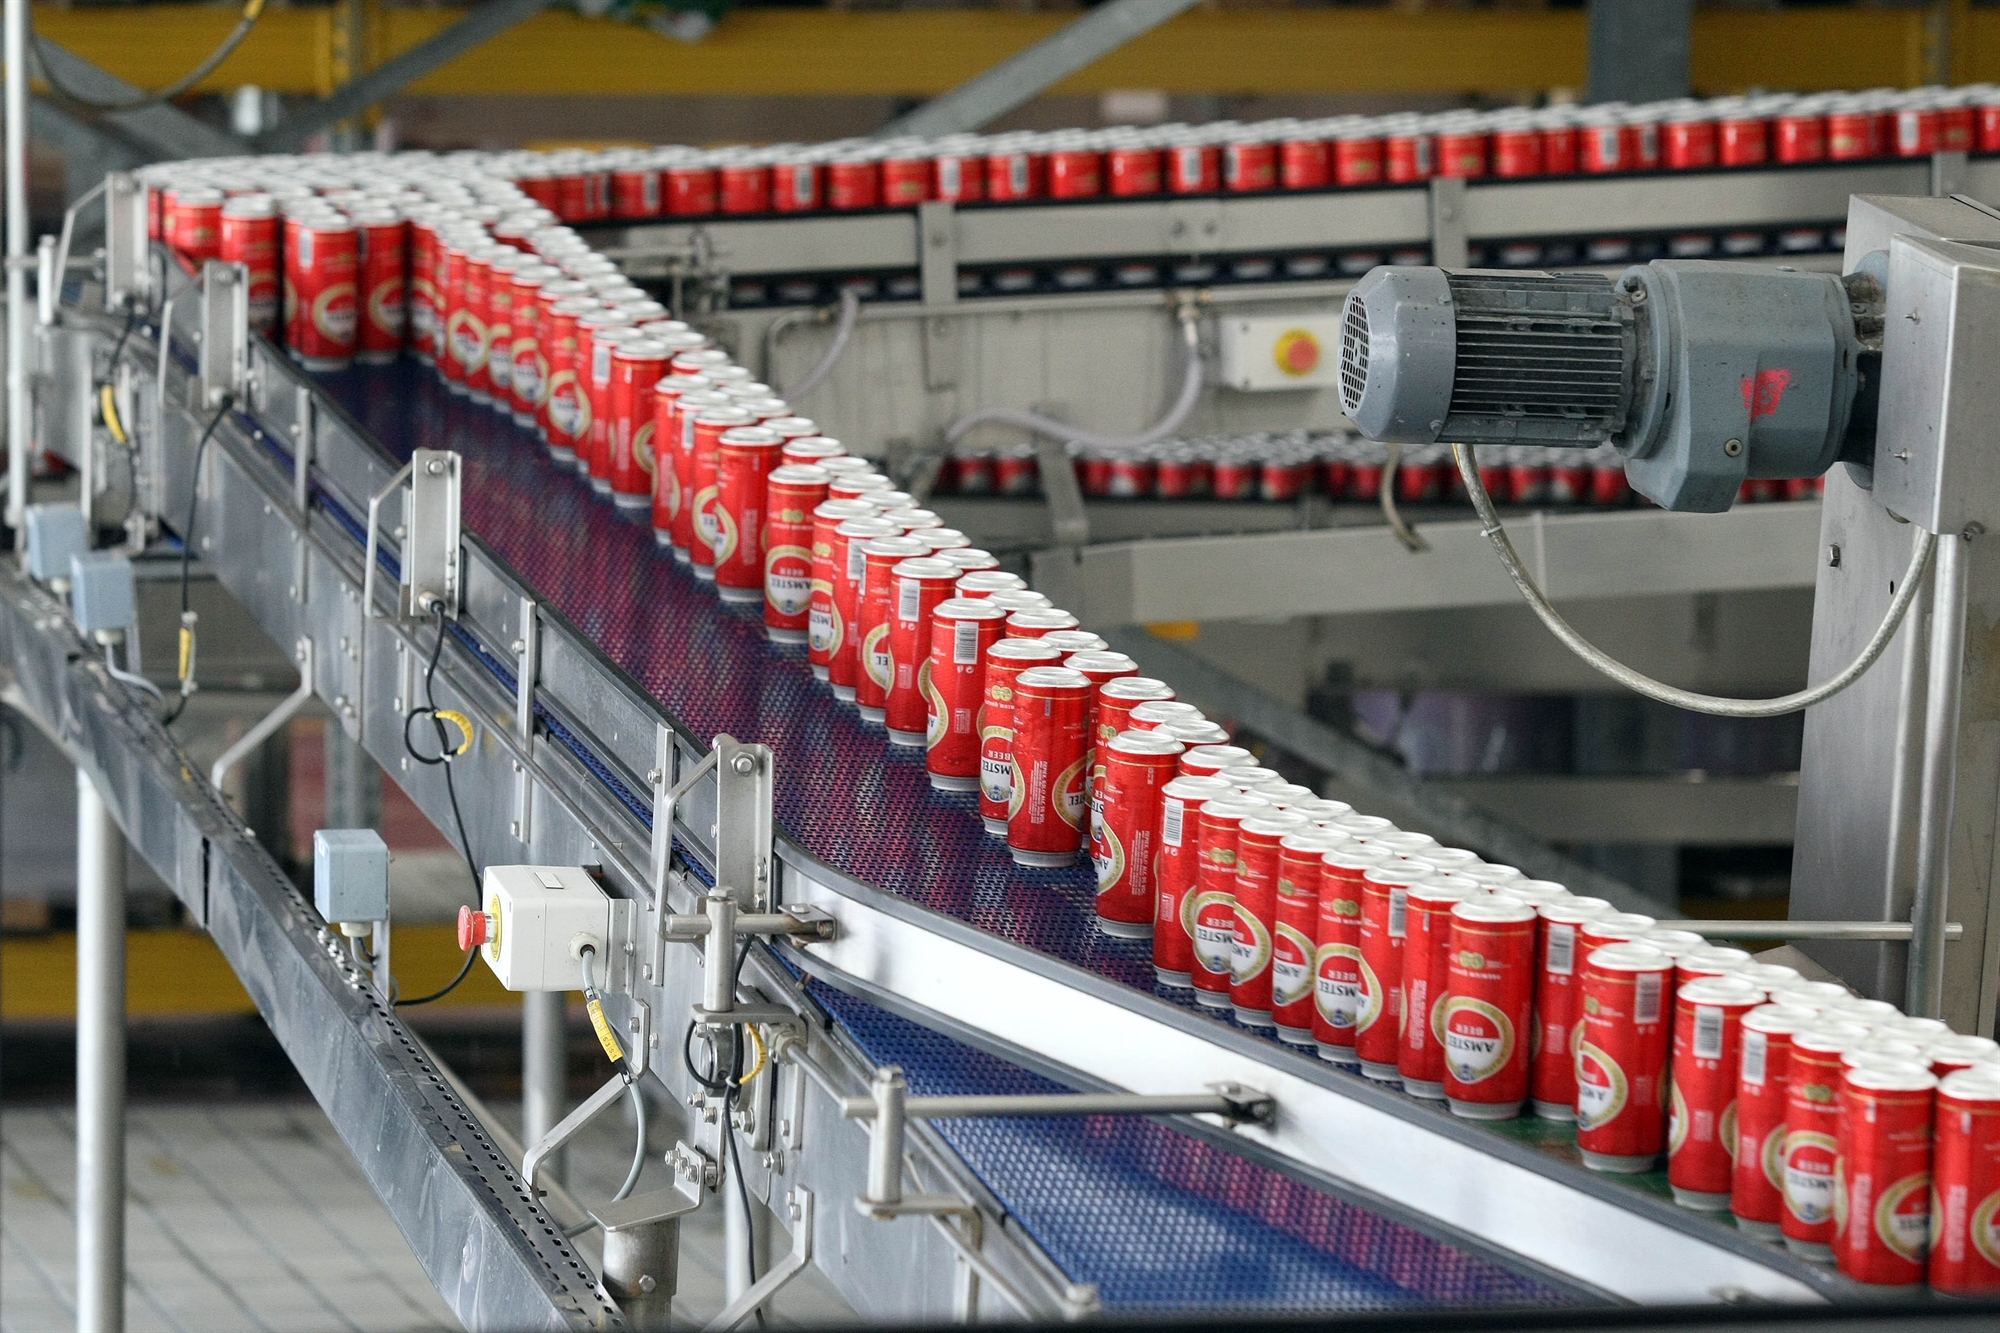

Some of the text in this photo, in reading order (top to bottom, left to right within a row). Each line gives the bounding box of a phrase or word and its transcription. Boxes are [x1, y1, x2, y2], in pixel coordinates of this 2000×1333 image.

[988, 749, 1012, 760] BEER
[982, 759, 1012, 775] MSTEL
[1196, 928, 1233, 944] MSTEL
[1319, 980, 1358, 998] MSTEL
